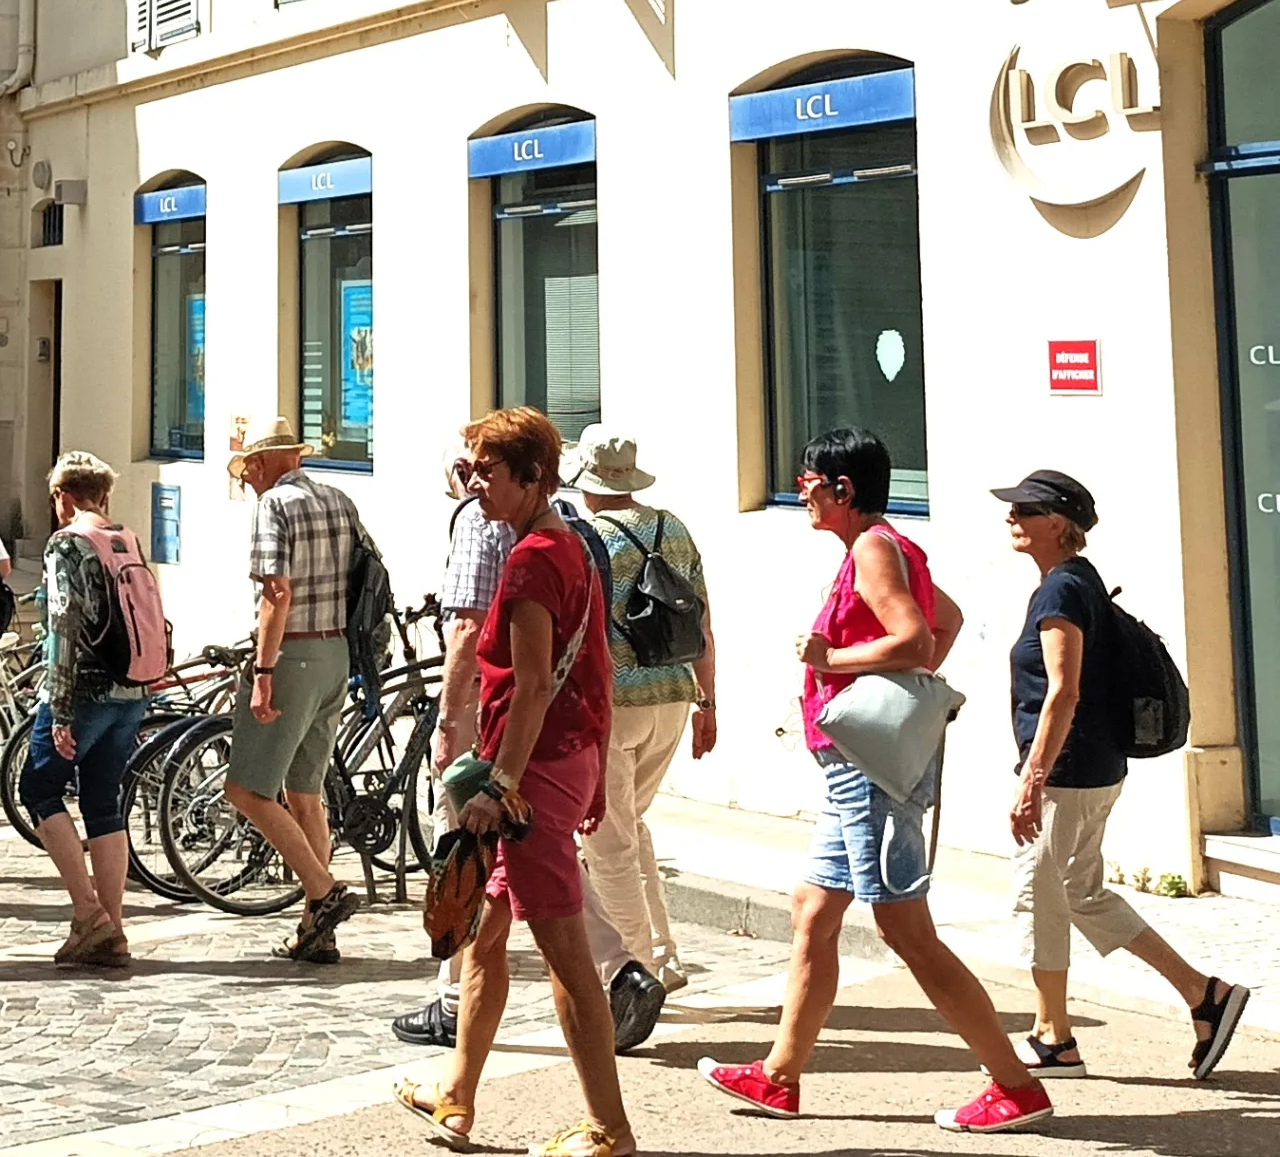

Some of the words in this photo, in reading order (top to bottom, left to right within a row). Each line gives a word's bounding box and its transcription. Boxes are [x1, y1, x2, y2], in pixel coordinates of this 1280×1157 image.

[1008, 52, 1161, 135] LCL
[795, 94, 838, 120] LCL
[514, 139, 544, 162] LCL
[311, 172, 335, 191] LCL
[160, 196, 178, 214] LCL
